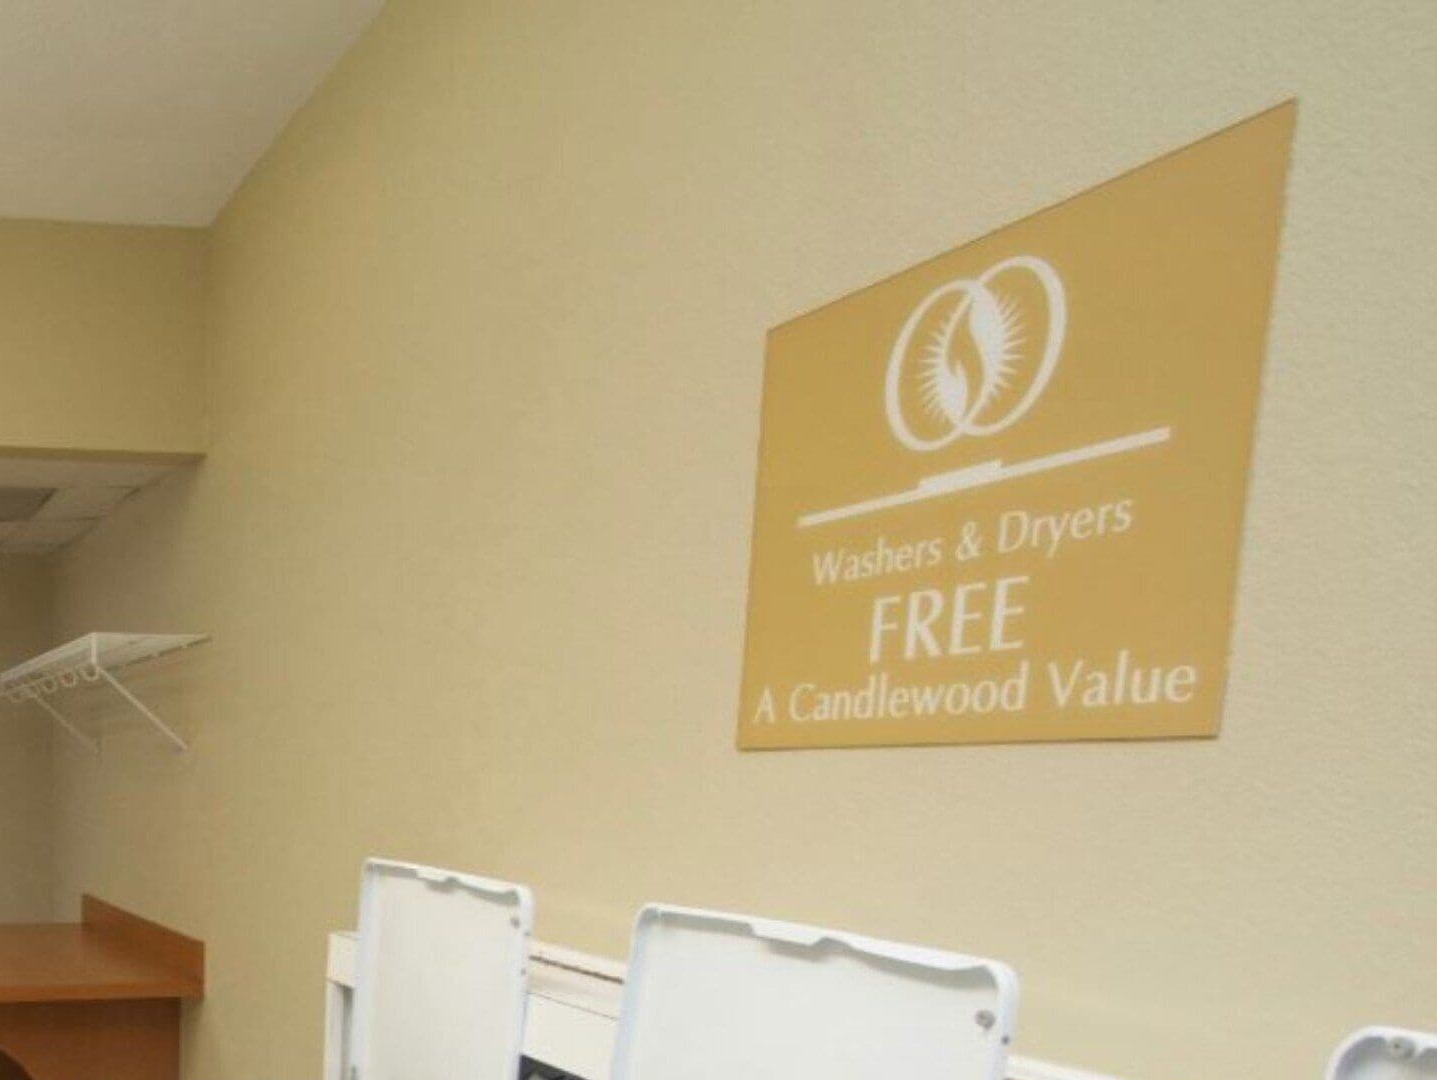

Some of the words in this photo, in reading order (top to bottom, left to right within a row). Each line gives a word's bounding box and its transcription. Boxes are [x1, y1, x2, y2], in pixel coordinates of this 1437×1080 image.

[811, 535, 943, 587] Washers
[955, 520, 982, 562] &
[997, 498, 1135, 559] Dryers
[869, 575, 1031, 665] FREE
[753, 687, 776, 725] A
[789, 660, 1030, 722] Candlewood
[1048, 649, 1198, 708] Value
